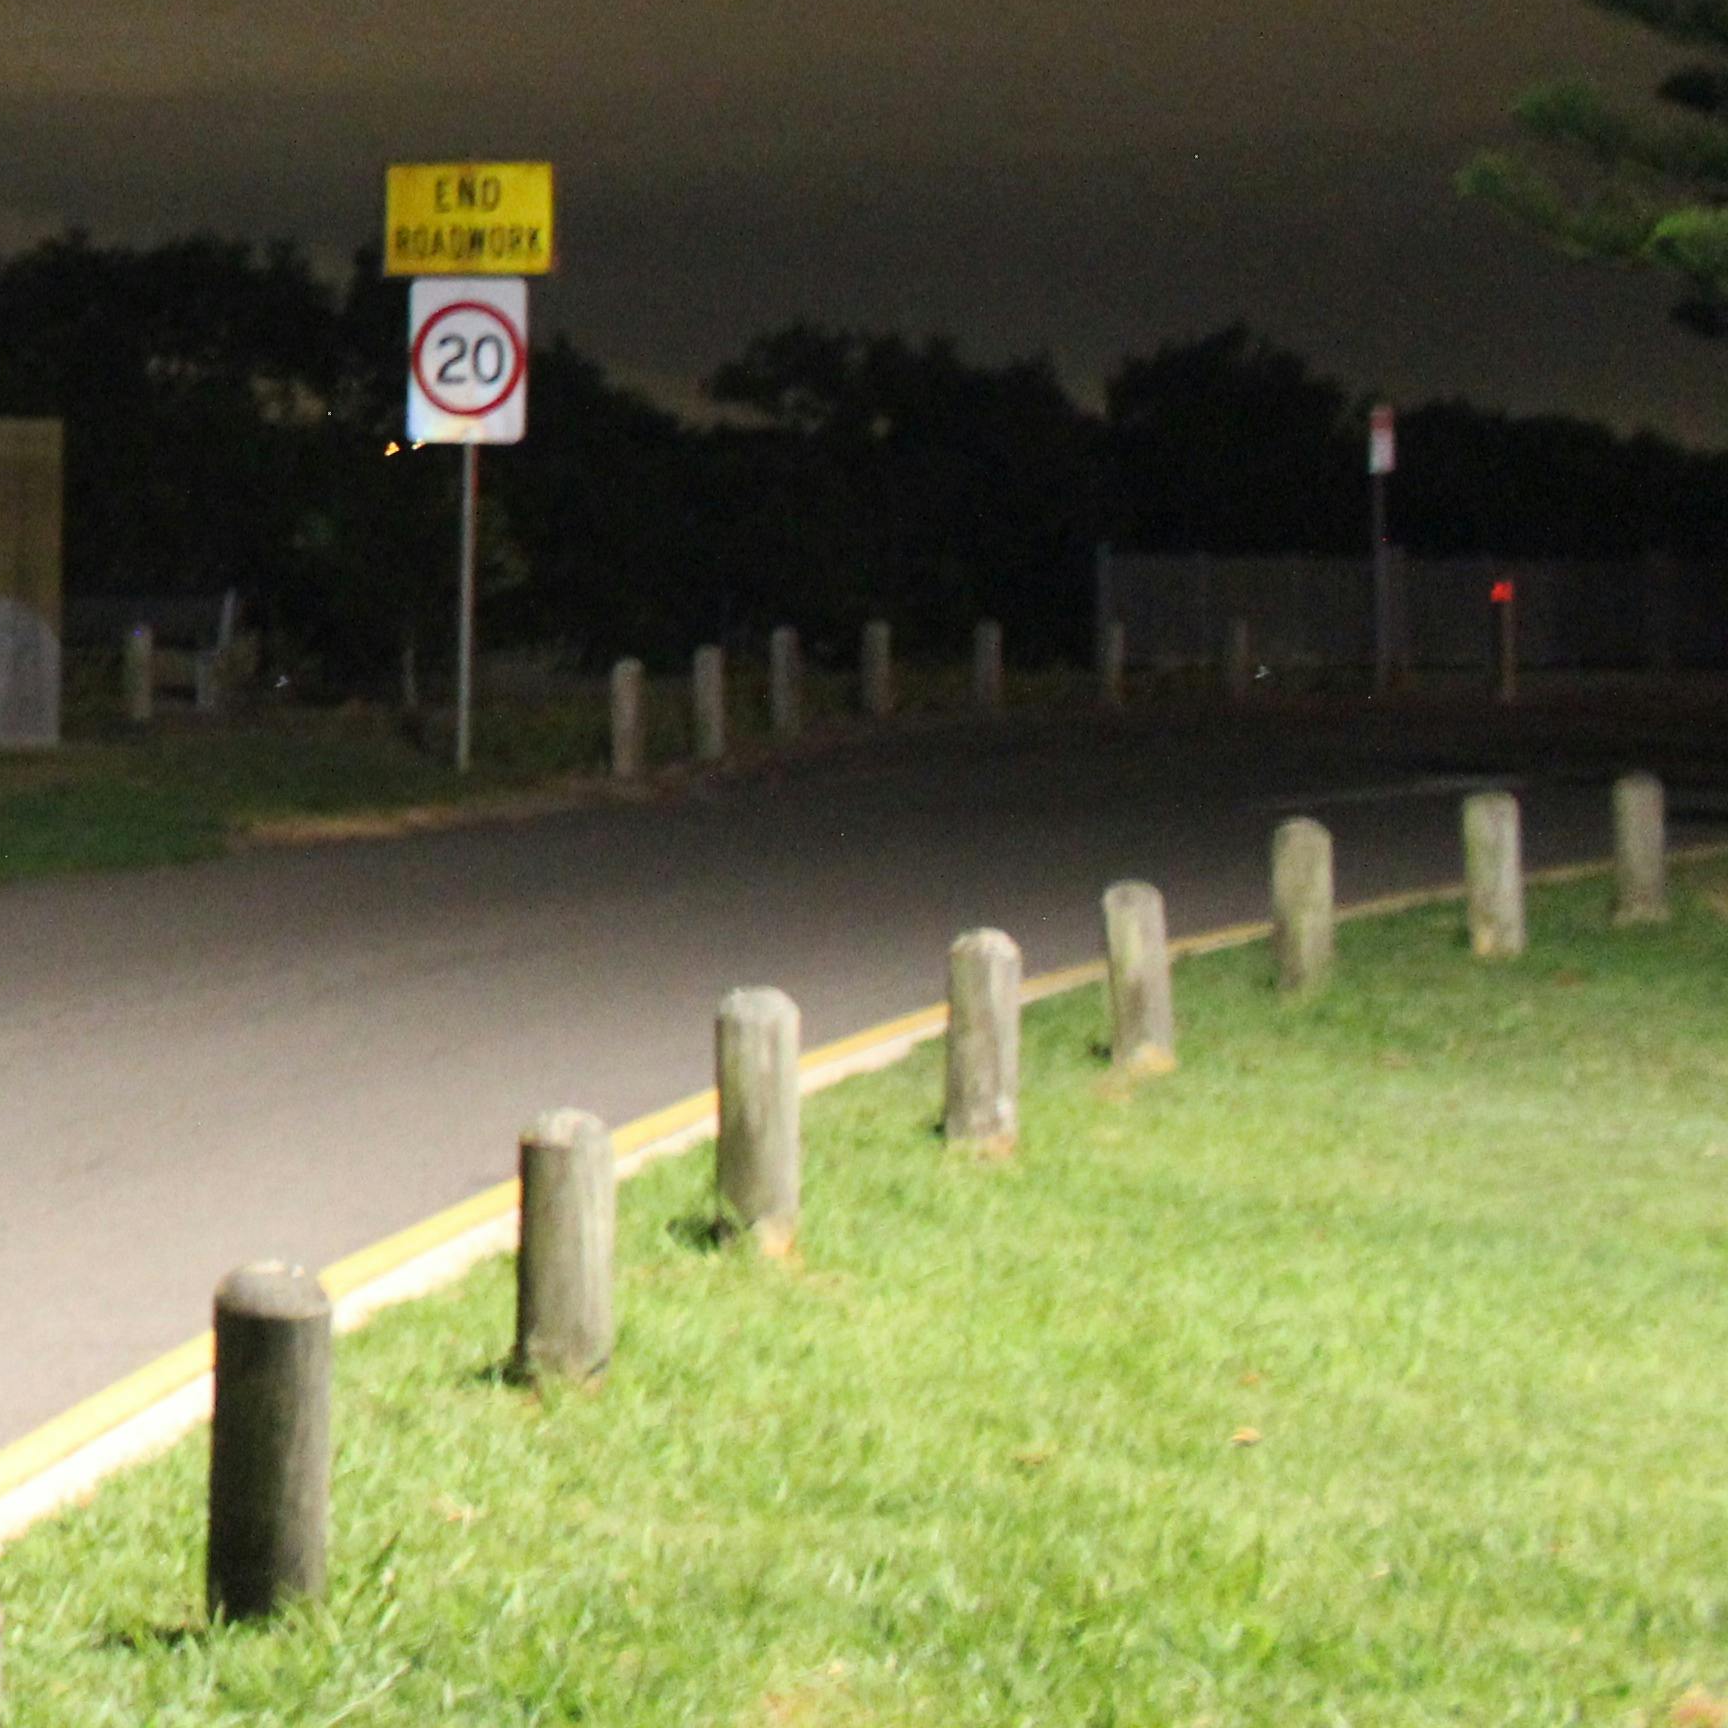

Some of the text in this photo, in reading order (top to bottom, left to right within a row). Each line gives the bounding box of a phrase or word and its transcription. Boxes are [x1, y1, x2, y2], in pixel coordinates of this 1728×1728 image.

[436, 176, 500, 213] END
[396, 226, 542, 260] ROADWORK
[437, 333, 504, 384] 20
